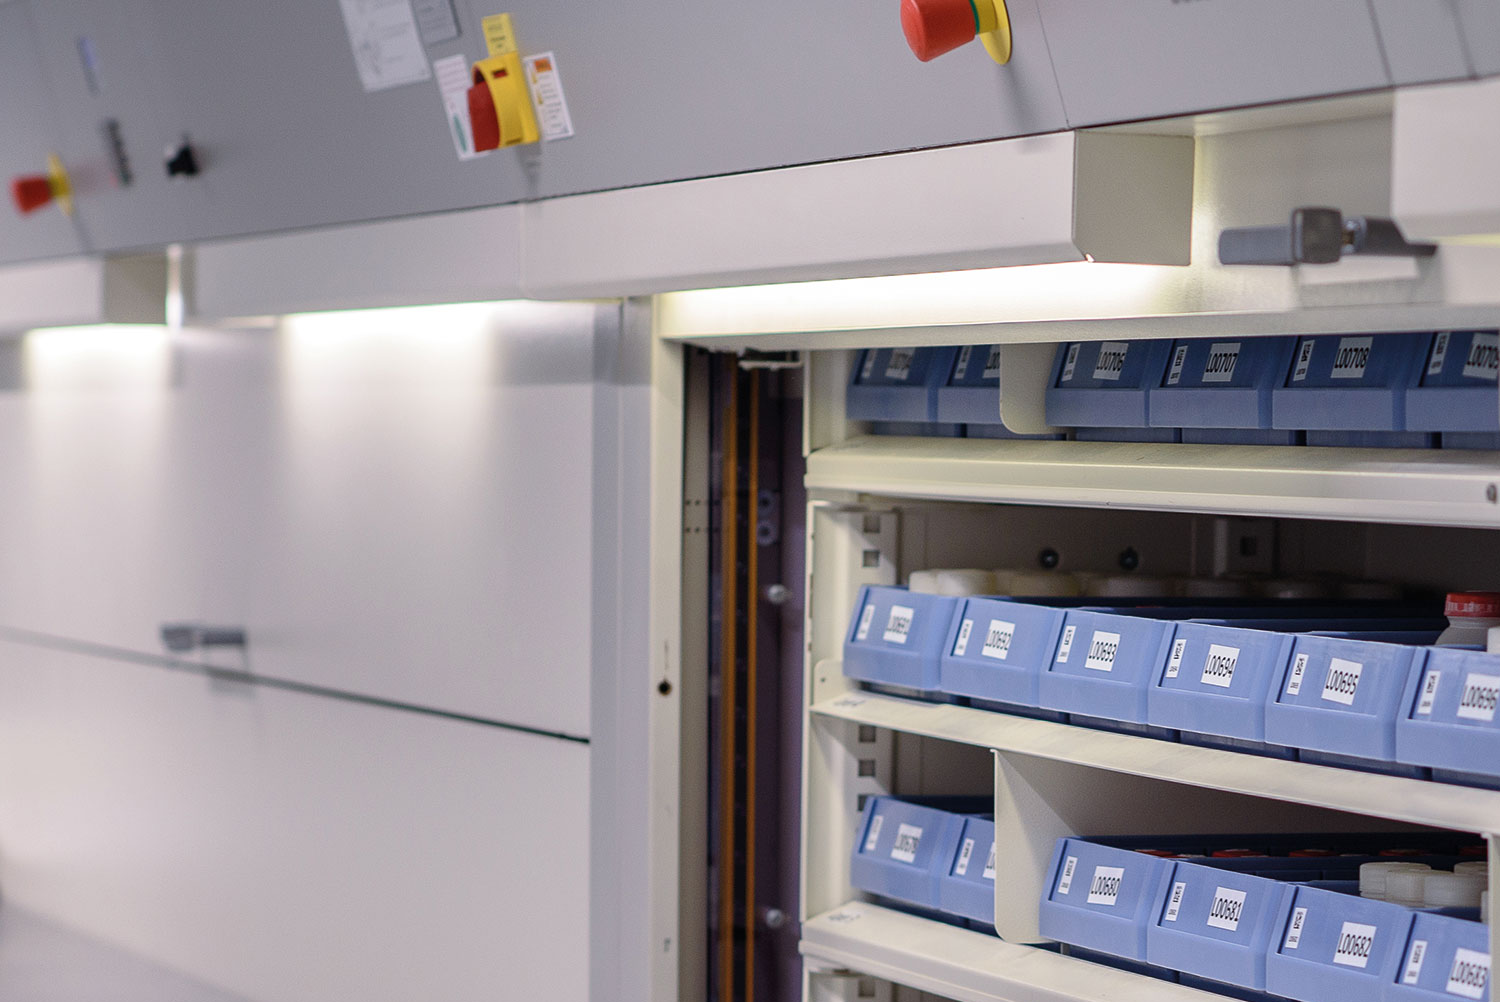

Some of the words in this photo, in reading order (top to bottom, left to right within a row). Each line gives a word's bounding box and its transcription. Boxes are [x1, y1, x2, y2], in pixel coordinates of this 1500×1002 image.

[1206, 353, 1238, 372] L00707
[1334, 347, 1370, 368] L00708
[1088, 642, 1117, 662] L00693
[1204, 654, 1235, 677] L00694
[1325, 668, 1358, 694] L00695
[1460, 686, 1500, 710] L00696
[1211, 898, 1241, 921] L00681
[1337, 933, 1372, 957] L00682
[1450, 960, 1488, 987] L00683
